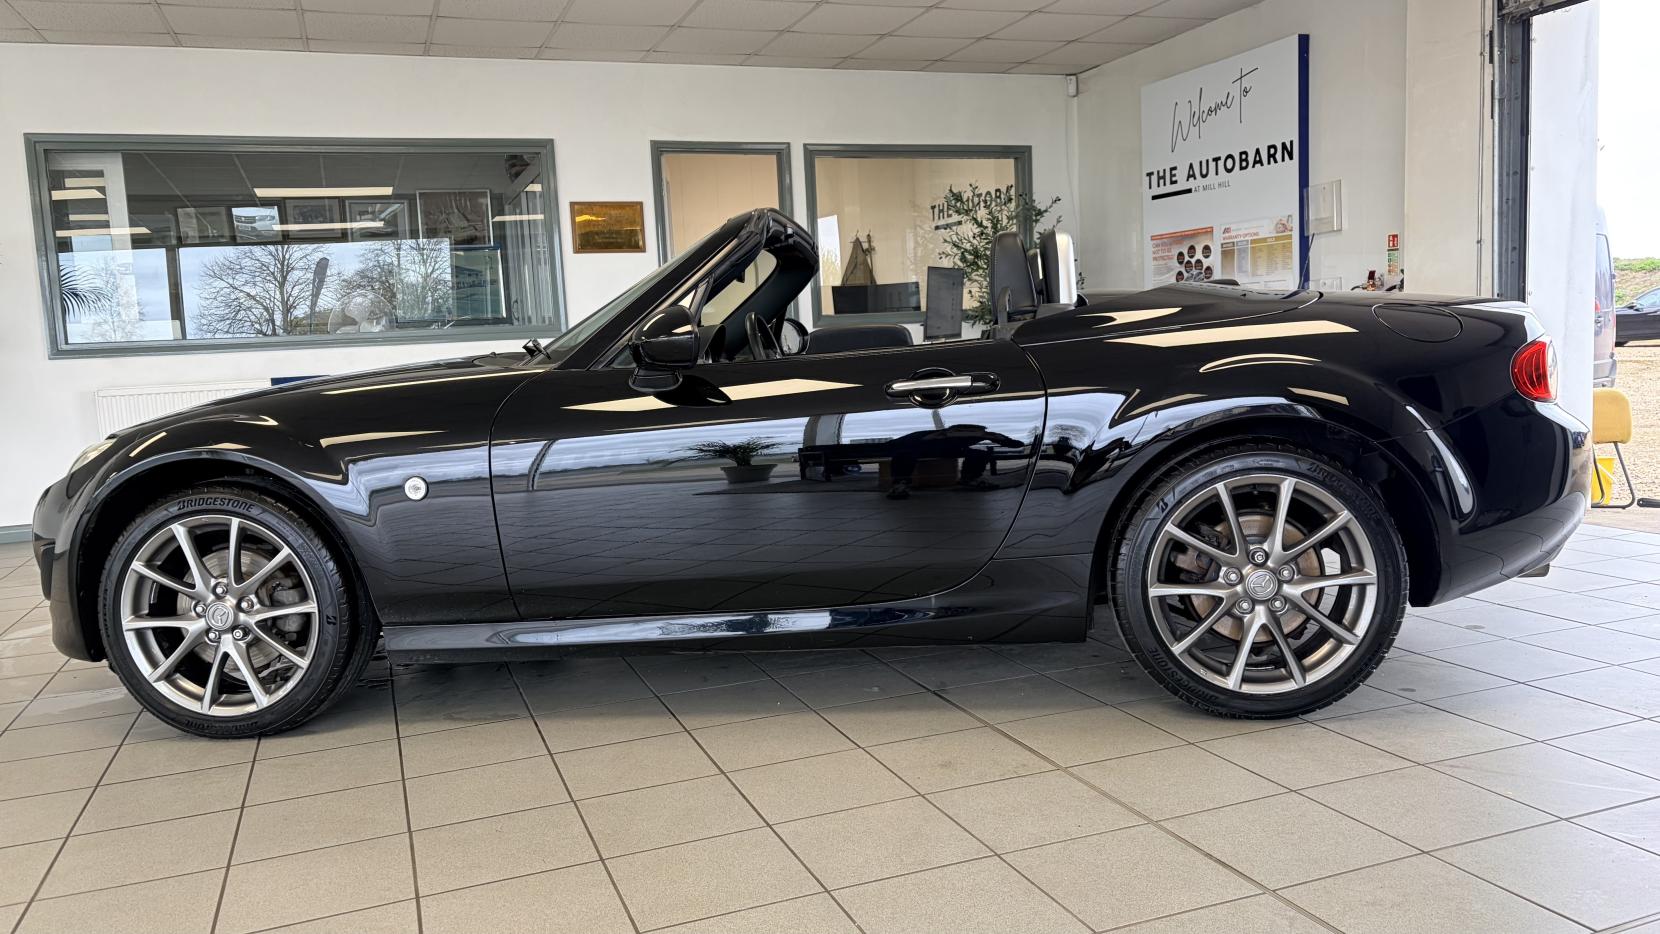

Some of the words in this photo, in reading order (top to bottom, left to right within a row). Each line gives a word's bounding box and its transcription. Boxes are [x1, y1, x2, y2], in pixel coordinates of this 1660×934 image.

[1171, 87, 1234, 153] Welcome
[1146, 166, 1178, 190] THE
[1186, 140, 1294, 182] AUTOBARN
[1202, 183, 1216, 192] MILL
[1218, 180, 1231, 188] HILL
[176, 496, 255, 513] BRIDGESTONE
